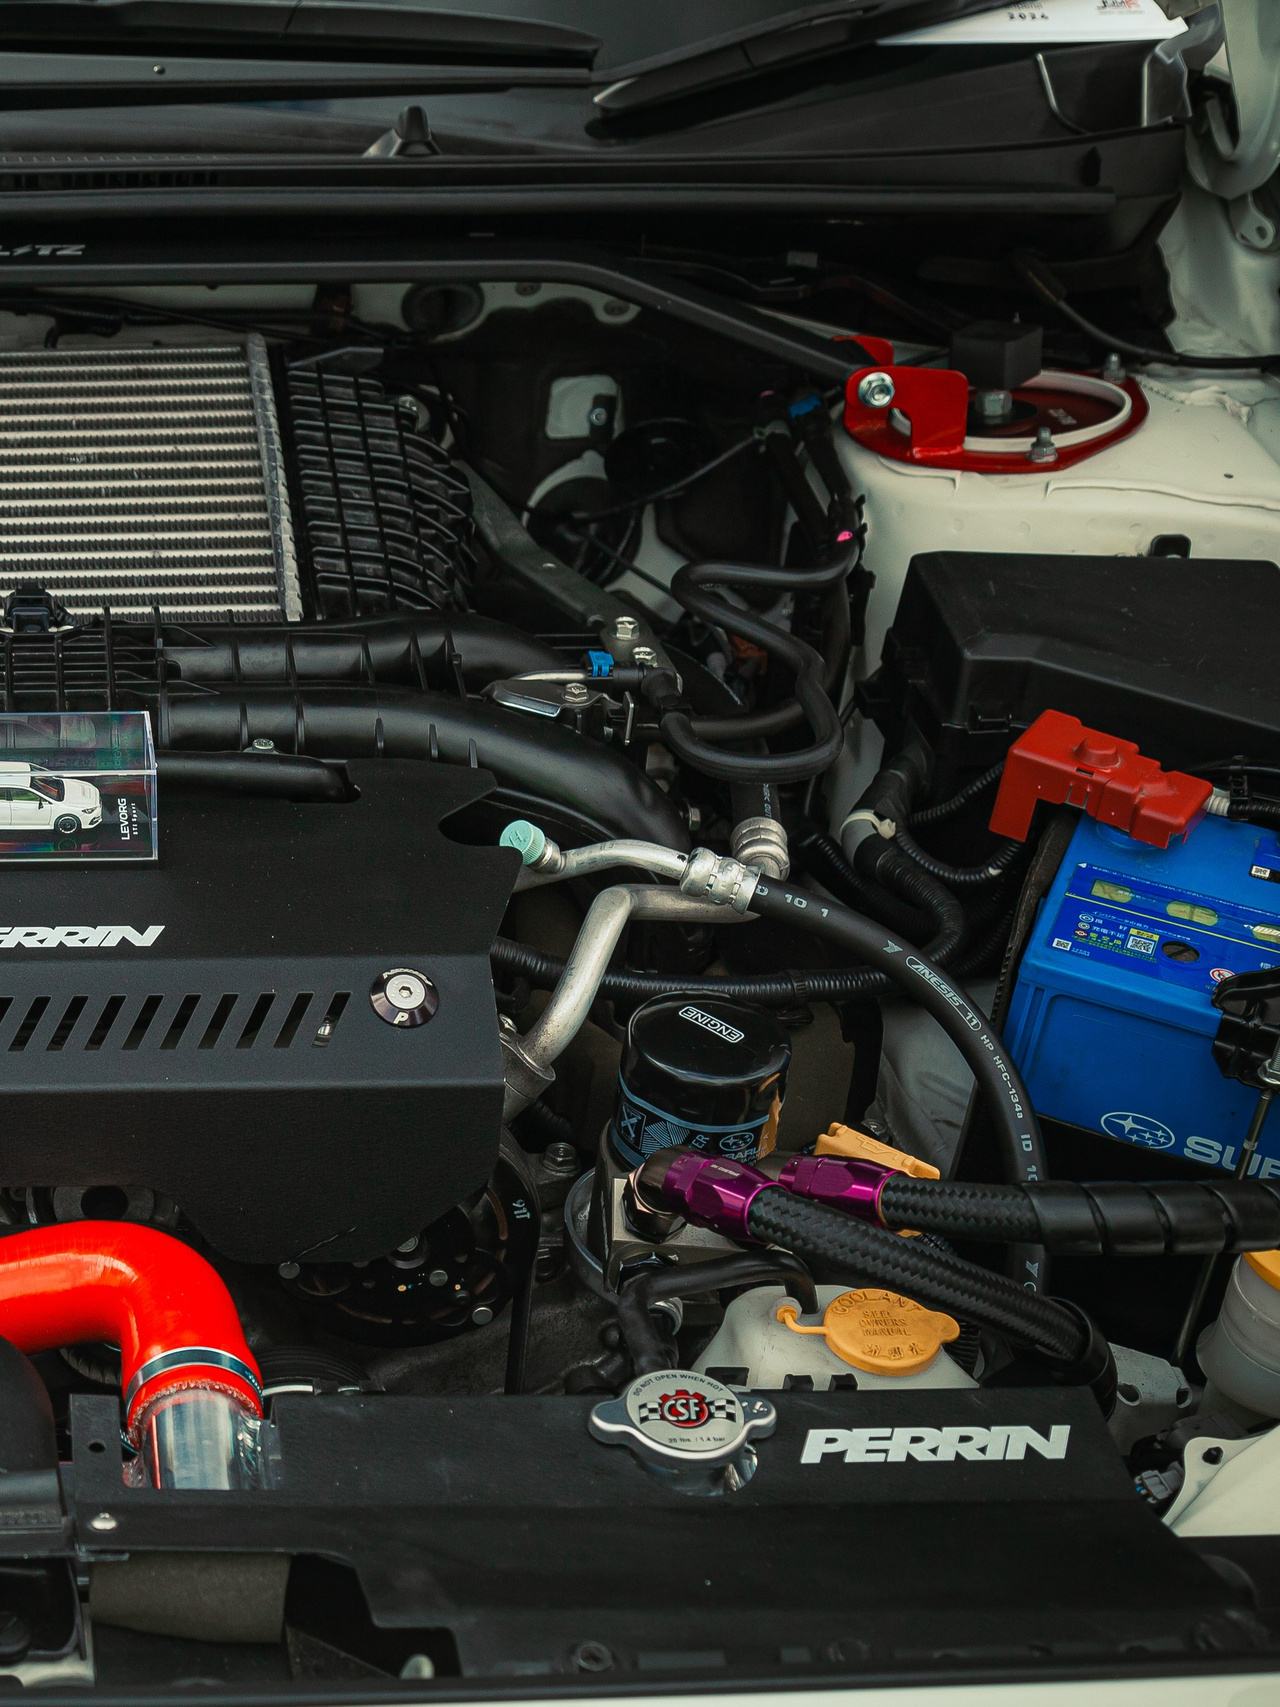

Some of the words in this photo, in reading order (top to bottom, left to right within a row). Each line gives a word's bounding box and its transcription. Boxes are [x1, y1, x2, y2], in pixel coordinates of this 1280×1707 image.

[117, 798, 130, 840] LEVORG
[784, 893, 807, 908] 10
[393, 1012, 409, 1024] P
[682, 1008, 740, 1041] ENGINE
[980, 1035, 995, 1051] HP
[1020, 1133, 1033, 1152] ID
[831, 1290, 924, 1315] COOLANT
[633, 1387, 643, 1397] DO
[641, 1378, 654, 1388] NOT
[654, 1373, 678, 1381] OPEN
[679, 1374, 705, 1384] WHEN
[706, 1381, 724, 1392] HOT
[663, 1399, 700, 1421] CSF
[800, 1424, 1071, 1464] PERRIN
